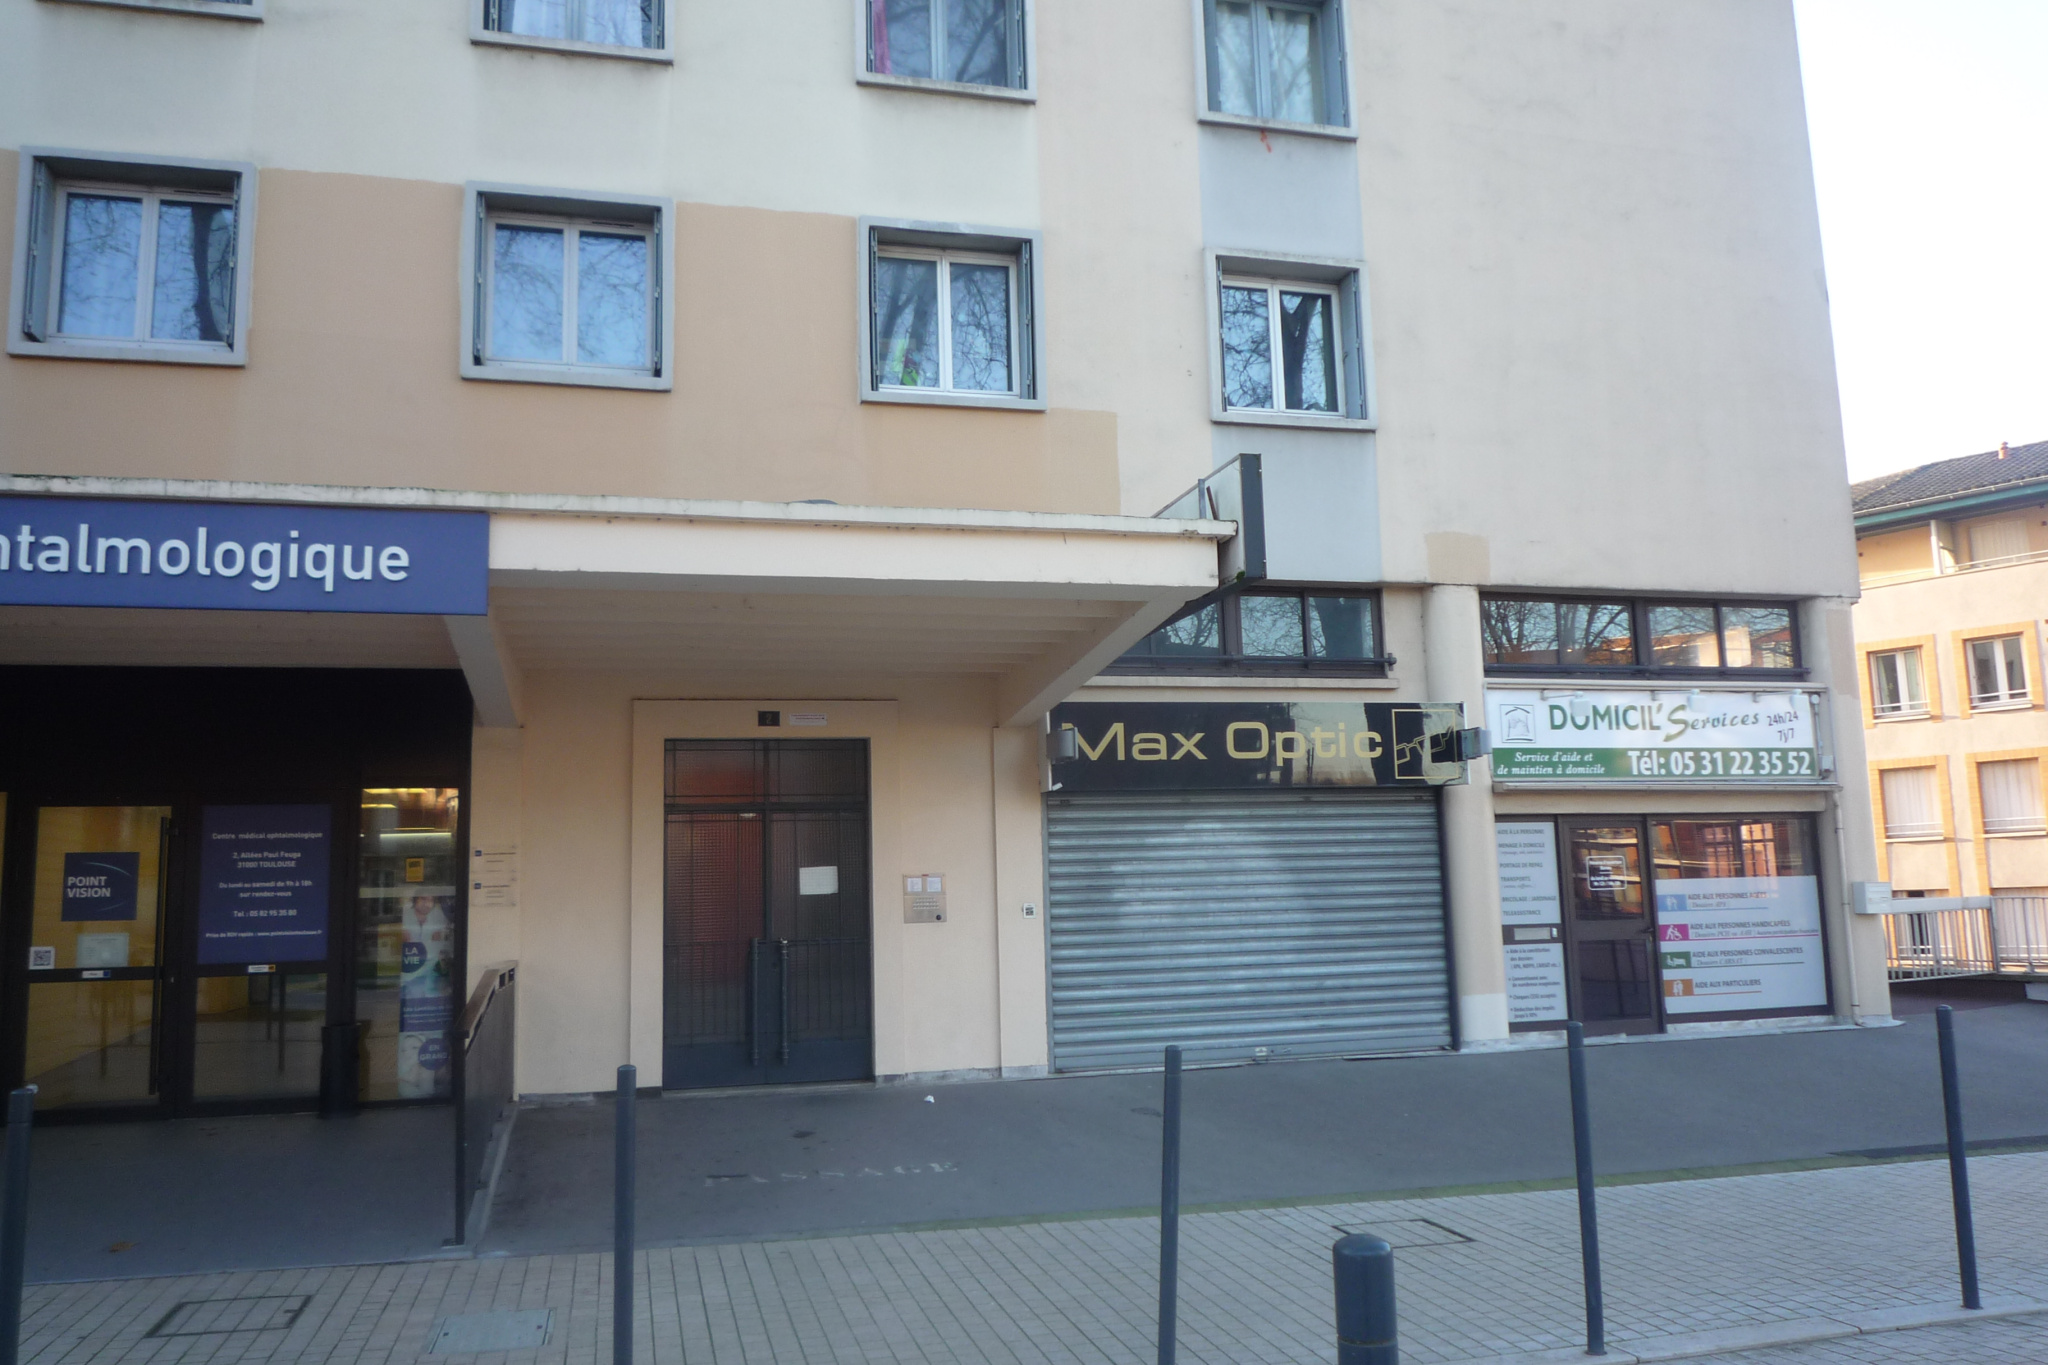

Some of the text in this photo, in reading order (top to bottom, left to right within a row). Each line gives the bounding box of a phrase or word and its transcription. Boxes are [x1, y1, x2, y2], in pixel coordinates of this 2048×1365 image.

[0, 523, 411, 592] talmologique
[1766, 710, 1799, 727] 24h/24
[1060, 721, 1383, 766] Max Optic
[1515, 751, 1593, 762] Service d'aide et
[1670, 751, 1695, 775] 05
[1700, 751, 1724, 775] 31
[1730, 751, 1754, 774] 22
[1759, 751, 1783, 774] 35
[1787, 750, 1811, 774] 52
[1497, 763, 1605, 775] de maintien à domicile
[259, 860, 296, 868] TOULOUSE
[67, 876, 107, 886] POINT
[67, 887, 111, 897] VISION
[405, 946, 419, 955] LA
[1692, 950, 1705, 958] AIDE
[1720, 949, 1753, 957] PERSONNES
[1754, 947, 1803, 956] CONVALESCENTES
[404, 956, 420, 964] VIE
[1709, 980, 1721, 988] AUX
[1722, 979, 1761, 987] PARTICULIERS
[428, 1044, 440, 1052] EN
